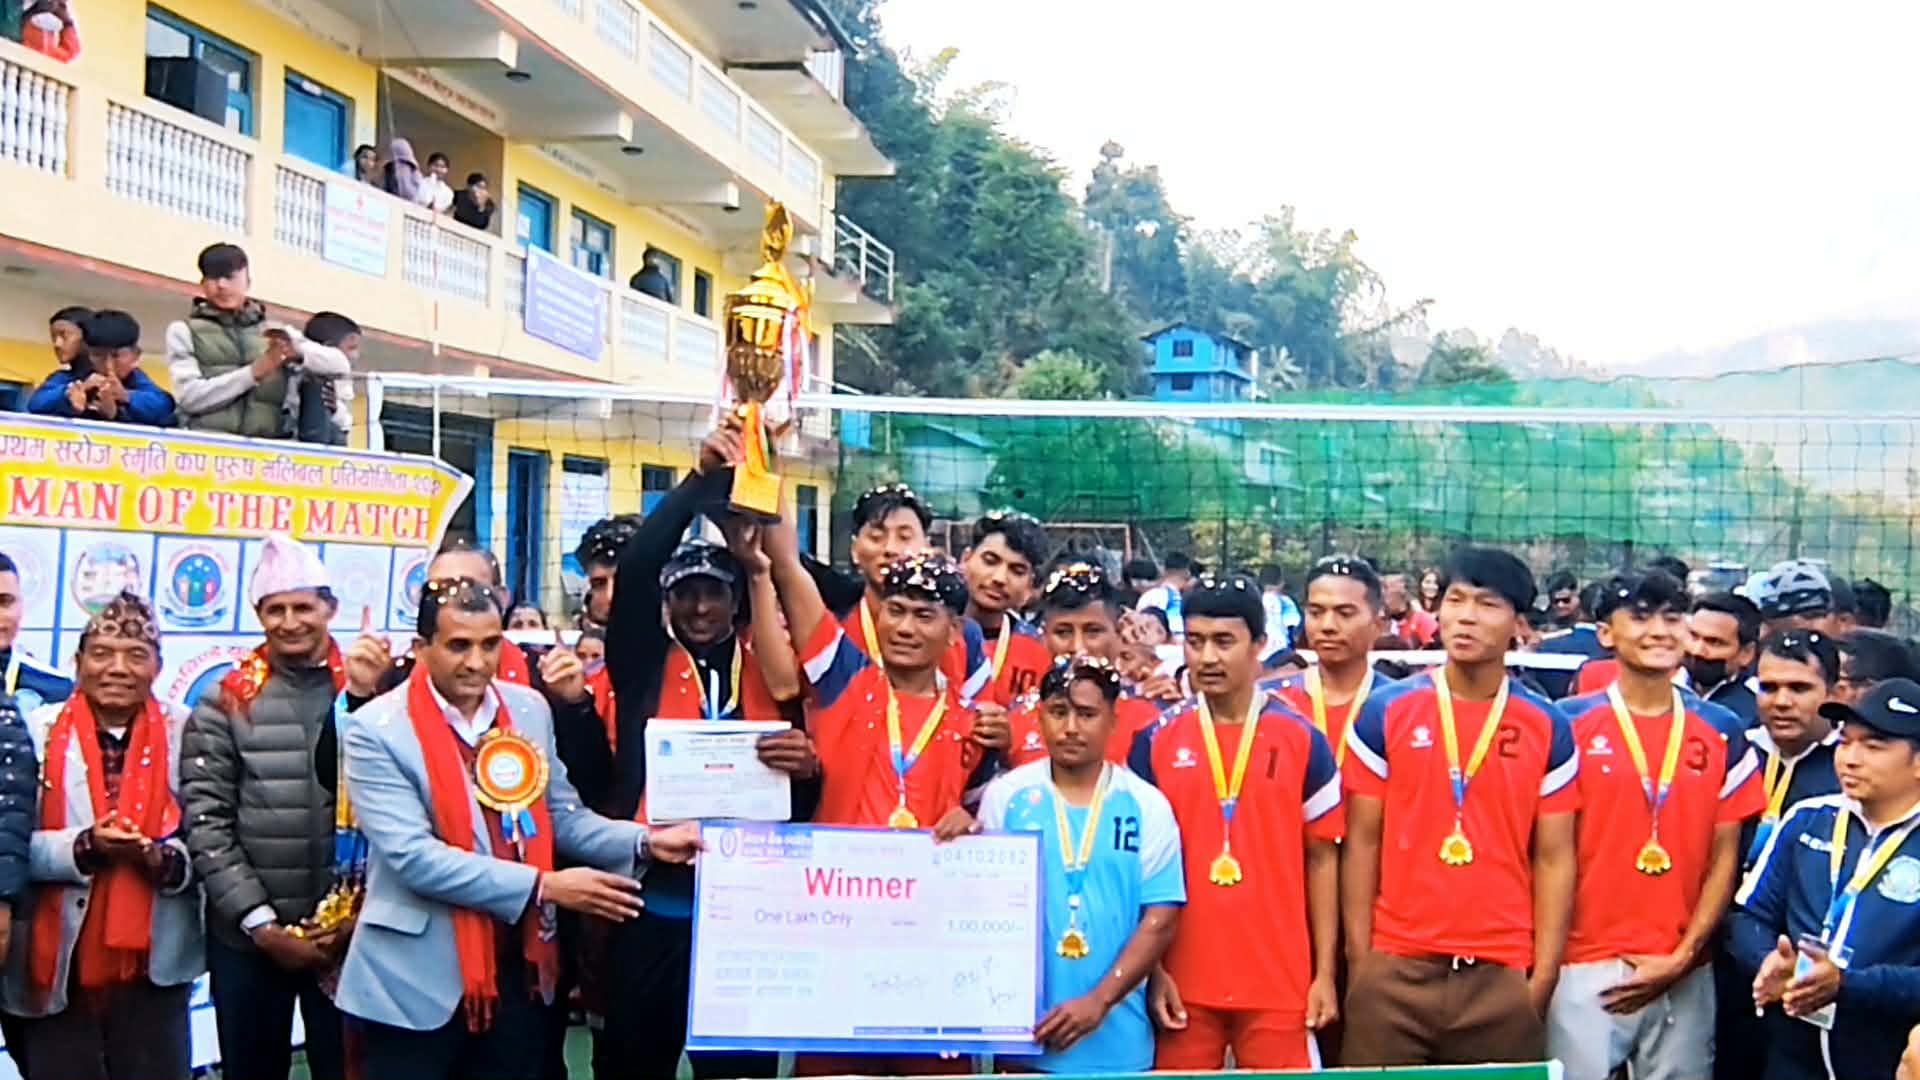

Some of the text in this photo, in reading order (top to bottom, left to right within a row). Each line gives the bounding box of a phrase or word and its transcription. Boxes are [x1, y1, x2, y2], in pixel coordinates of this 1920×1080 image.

[8, 475, 431, 540] MAN OF THE MATCH
[1498, 725, 1521, 758] 2
[1685, 735, 1710, 772] 3
[1113, 816, 1140, 852] 12
[805, 867, 916, 899] Winner
[754, 909, 783, 924] One
[822, 910, 852, 928] Only
